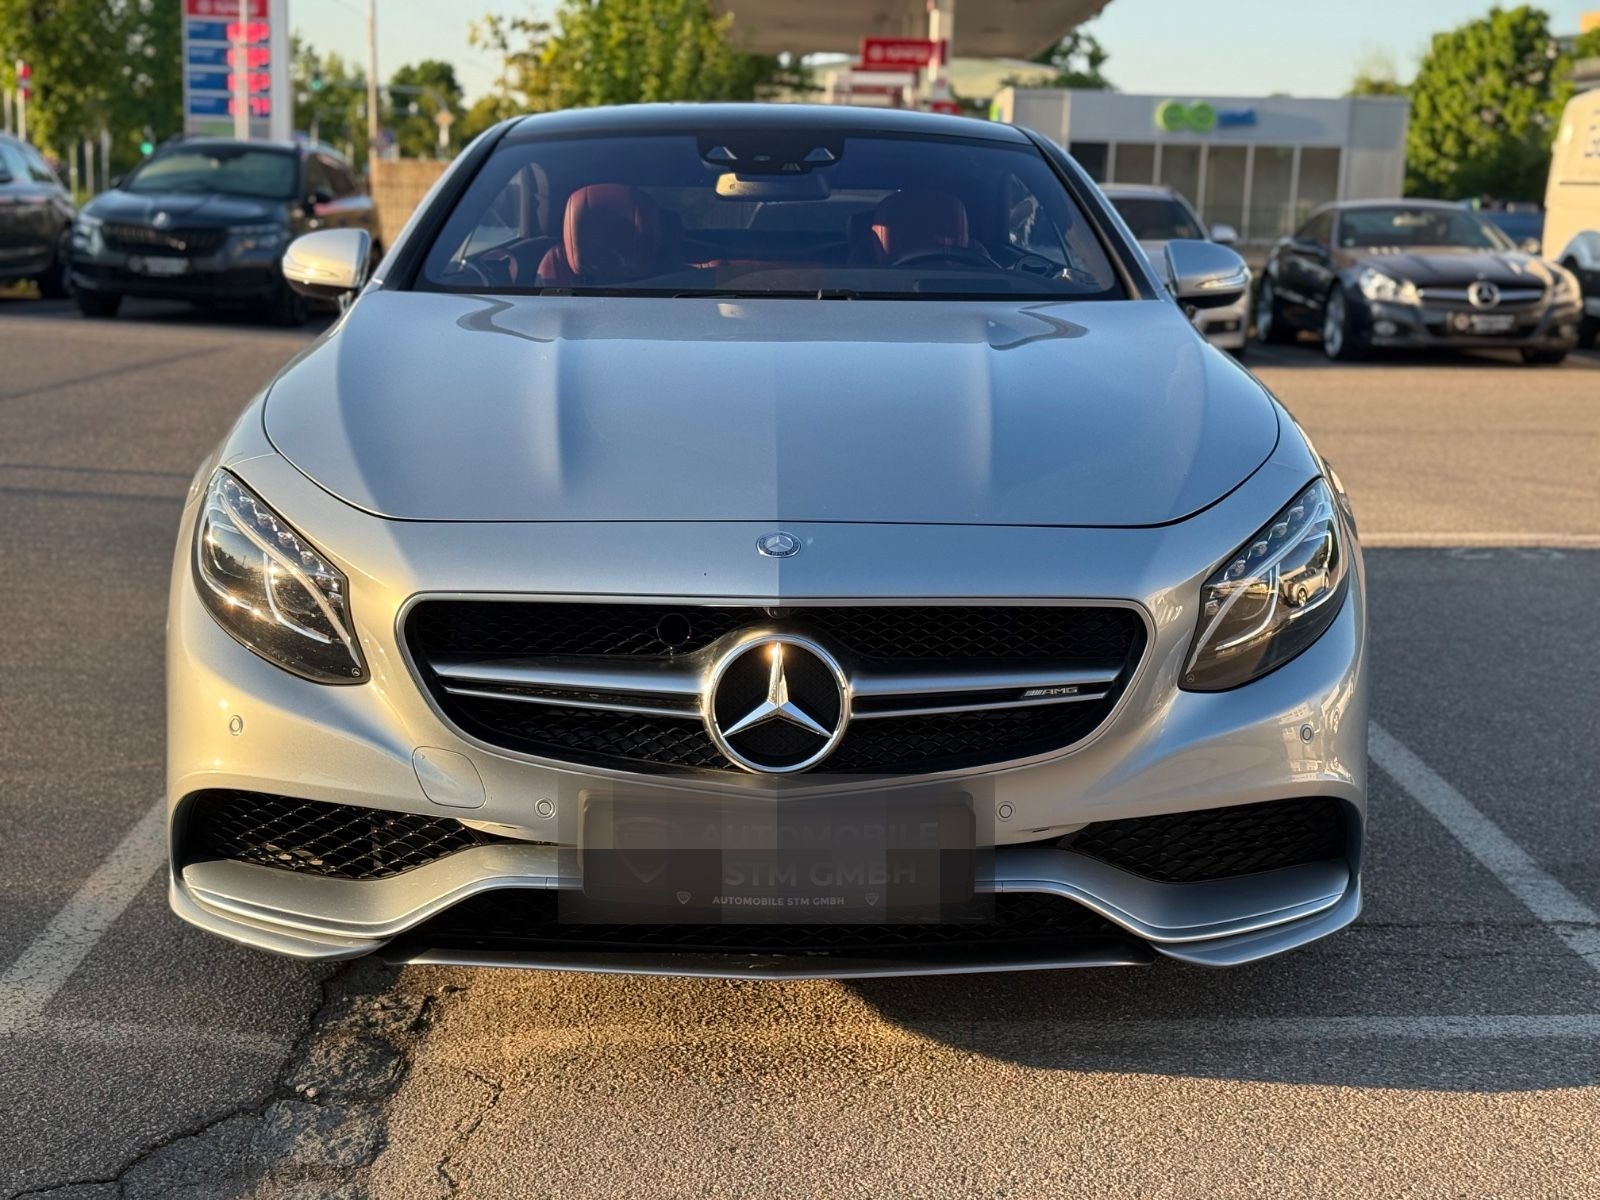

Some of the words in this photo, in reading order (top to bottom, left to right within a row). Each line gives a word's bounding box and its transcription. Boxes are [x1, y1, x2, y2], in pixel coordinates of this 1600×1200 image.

[1040, 686, 1078, 695] AMG
[699, 822, 938, 848] AUTOMOBILE
[724, 860, 797, 886] STM
[810, 859, 917, 886] GMBH
[712, 895, 784, 906] AUTOMOBILE
[786, 896, 809, 906] STM
[812, 896, 845, 906] GMBH
